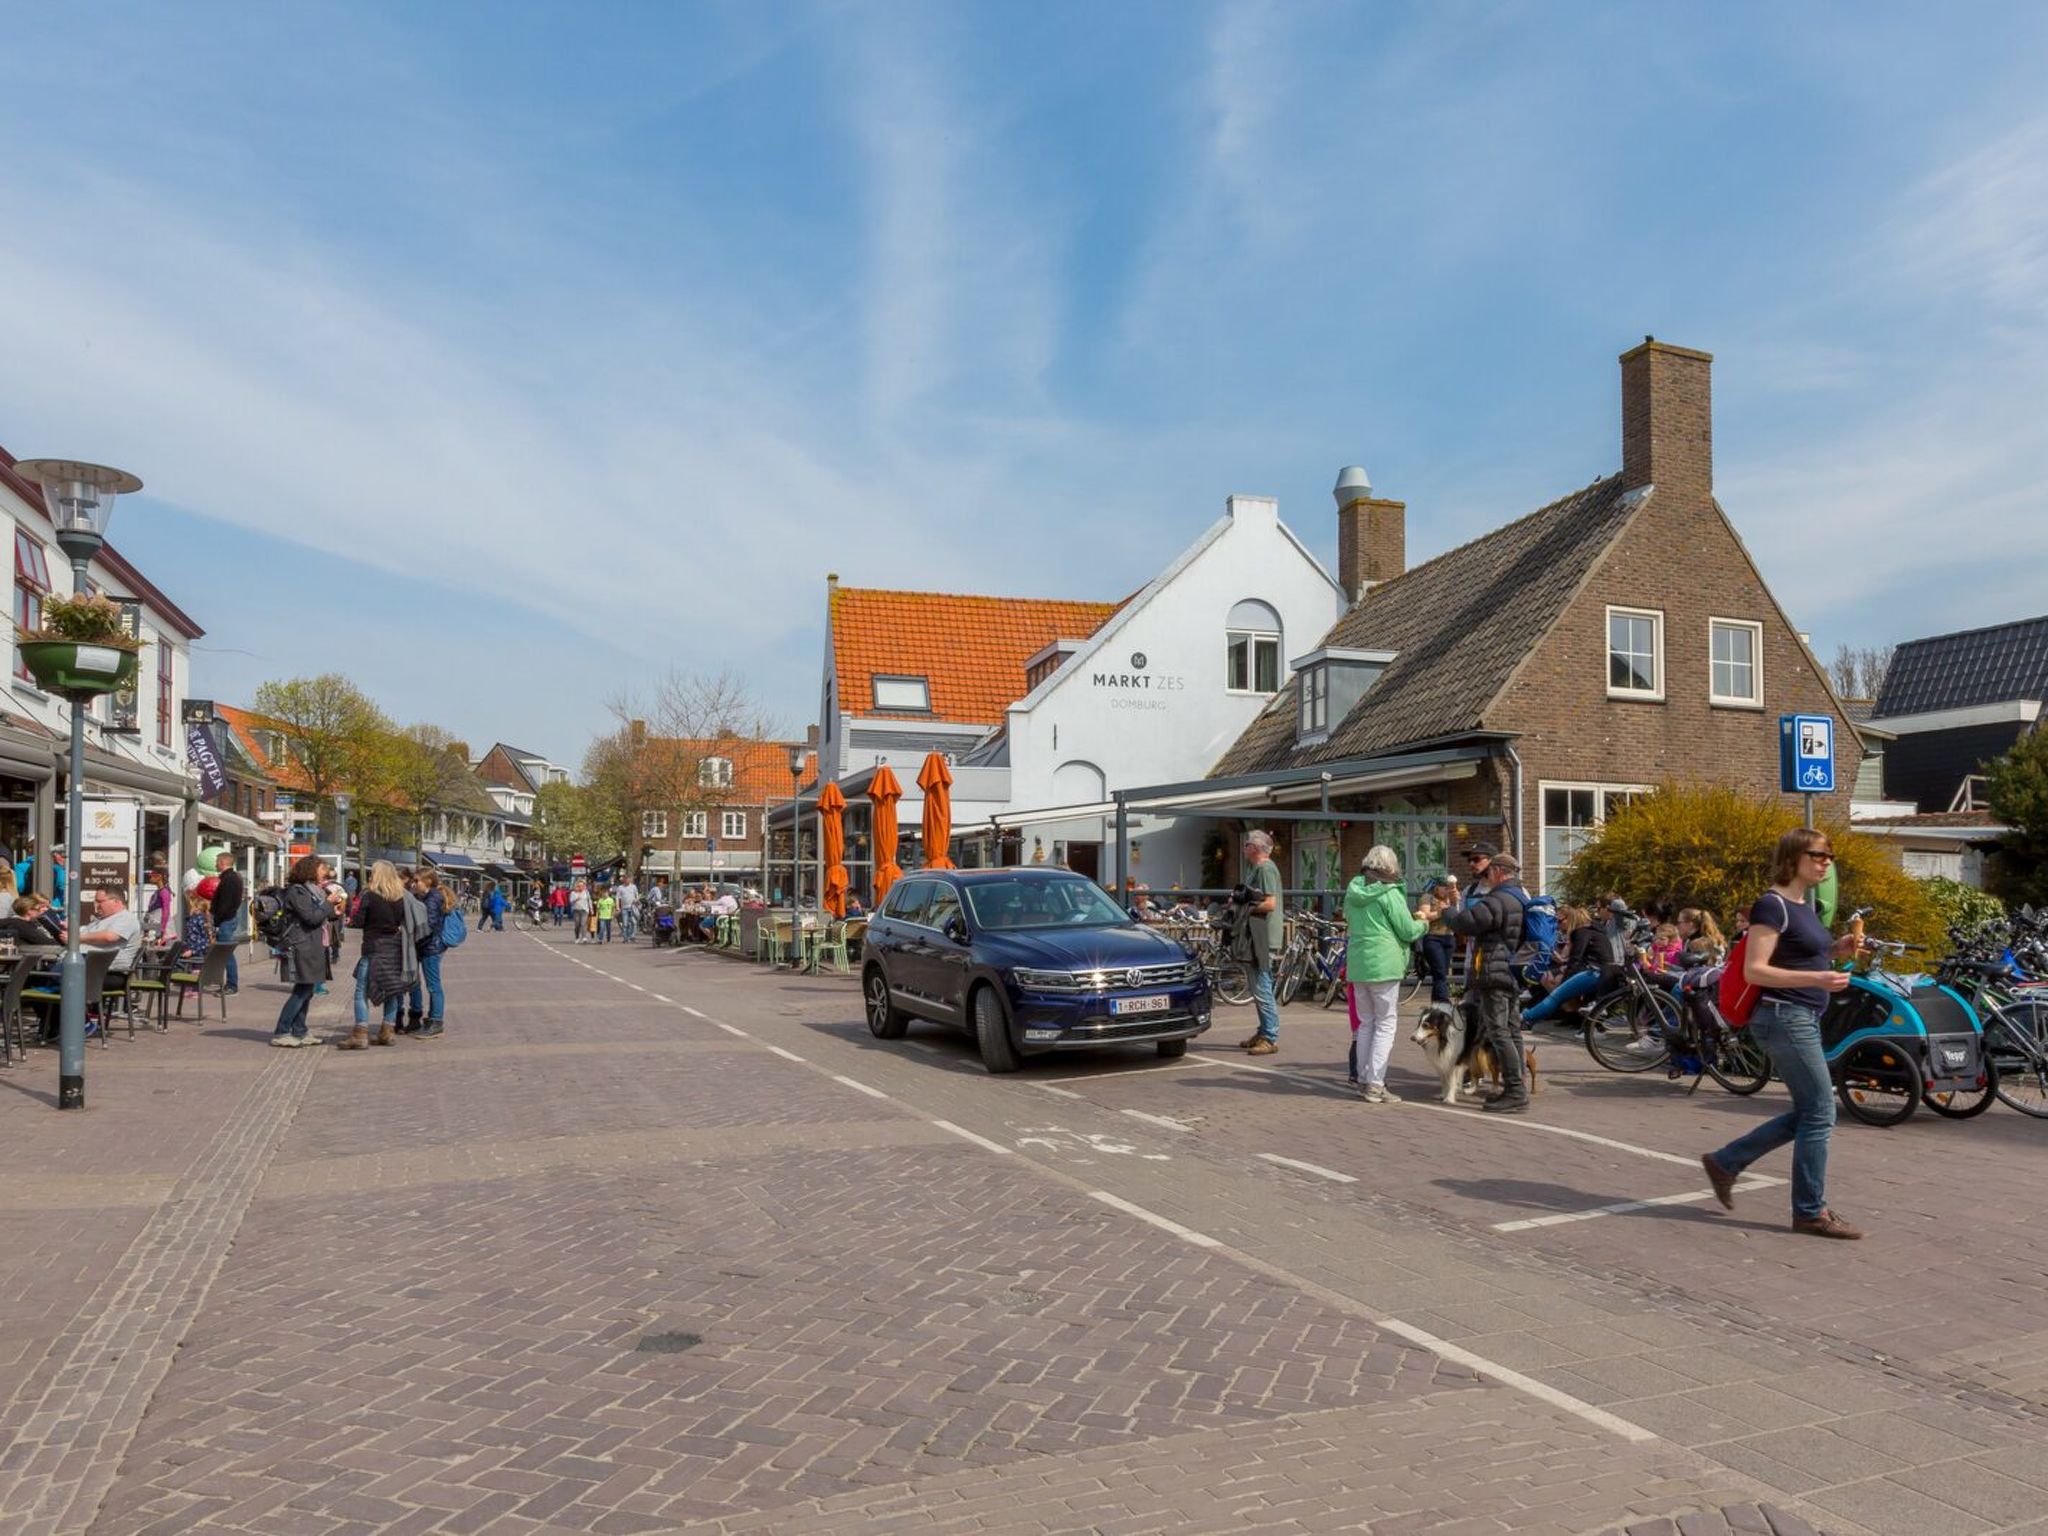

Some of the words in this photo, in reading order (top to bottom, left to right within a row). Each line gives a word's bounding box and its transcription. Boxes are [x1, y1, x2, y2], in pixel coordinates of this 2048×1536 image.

[1093, 673, 1151, 688] MARKT
[1156, 676, 1184, 690] ZES
[1110, 699, 1166, 710] DOMBURG
[192, 738, 224, 790] PAGTER
